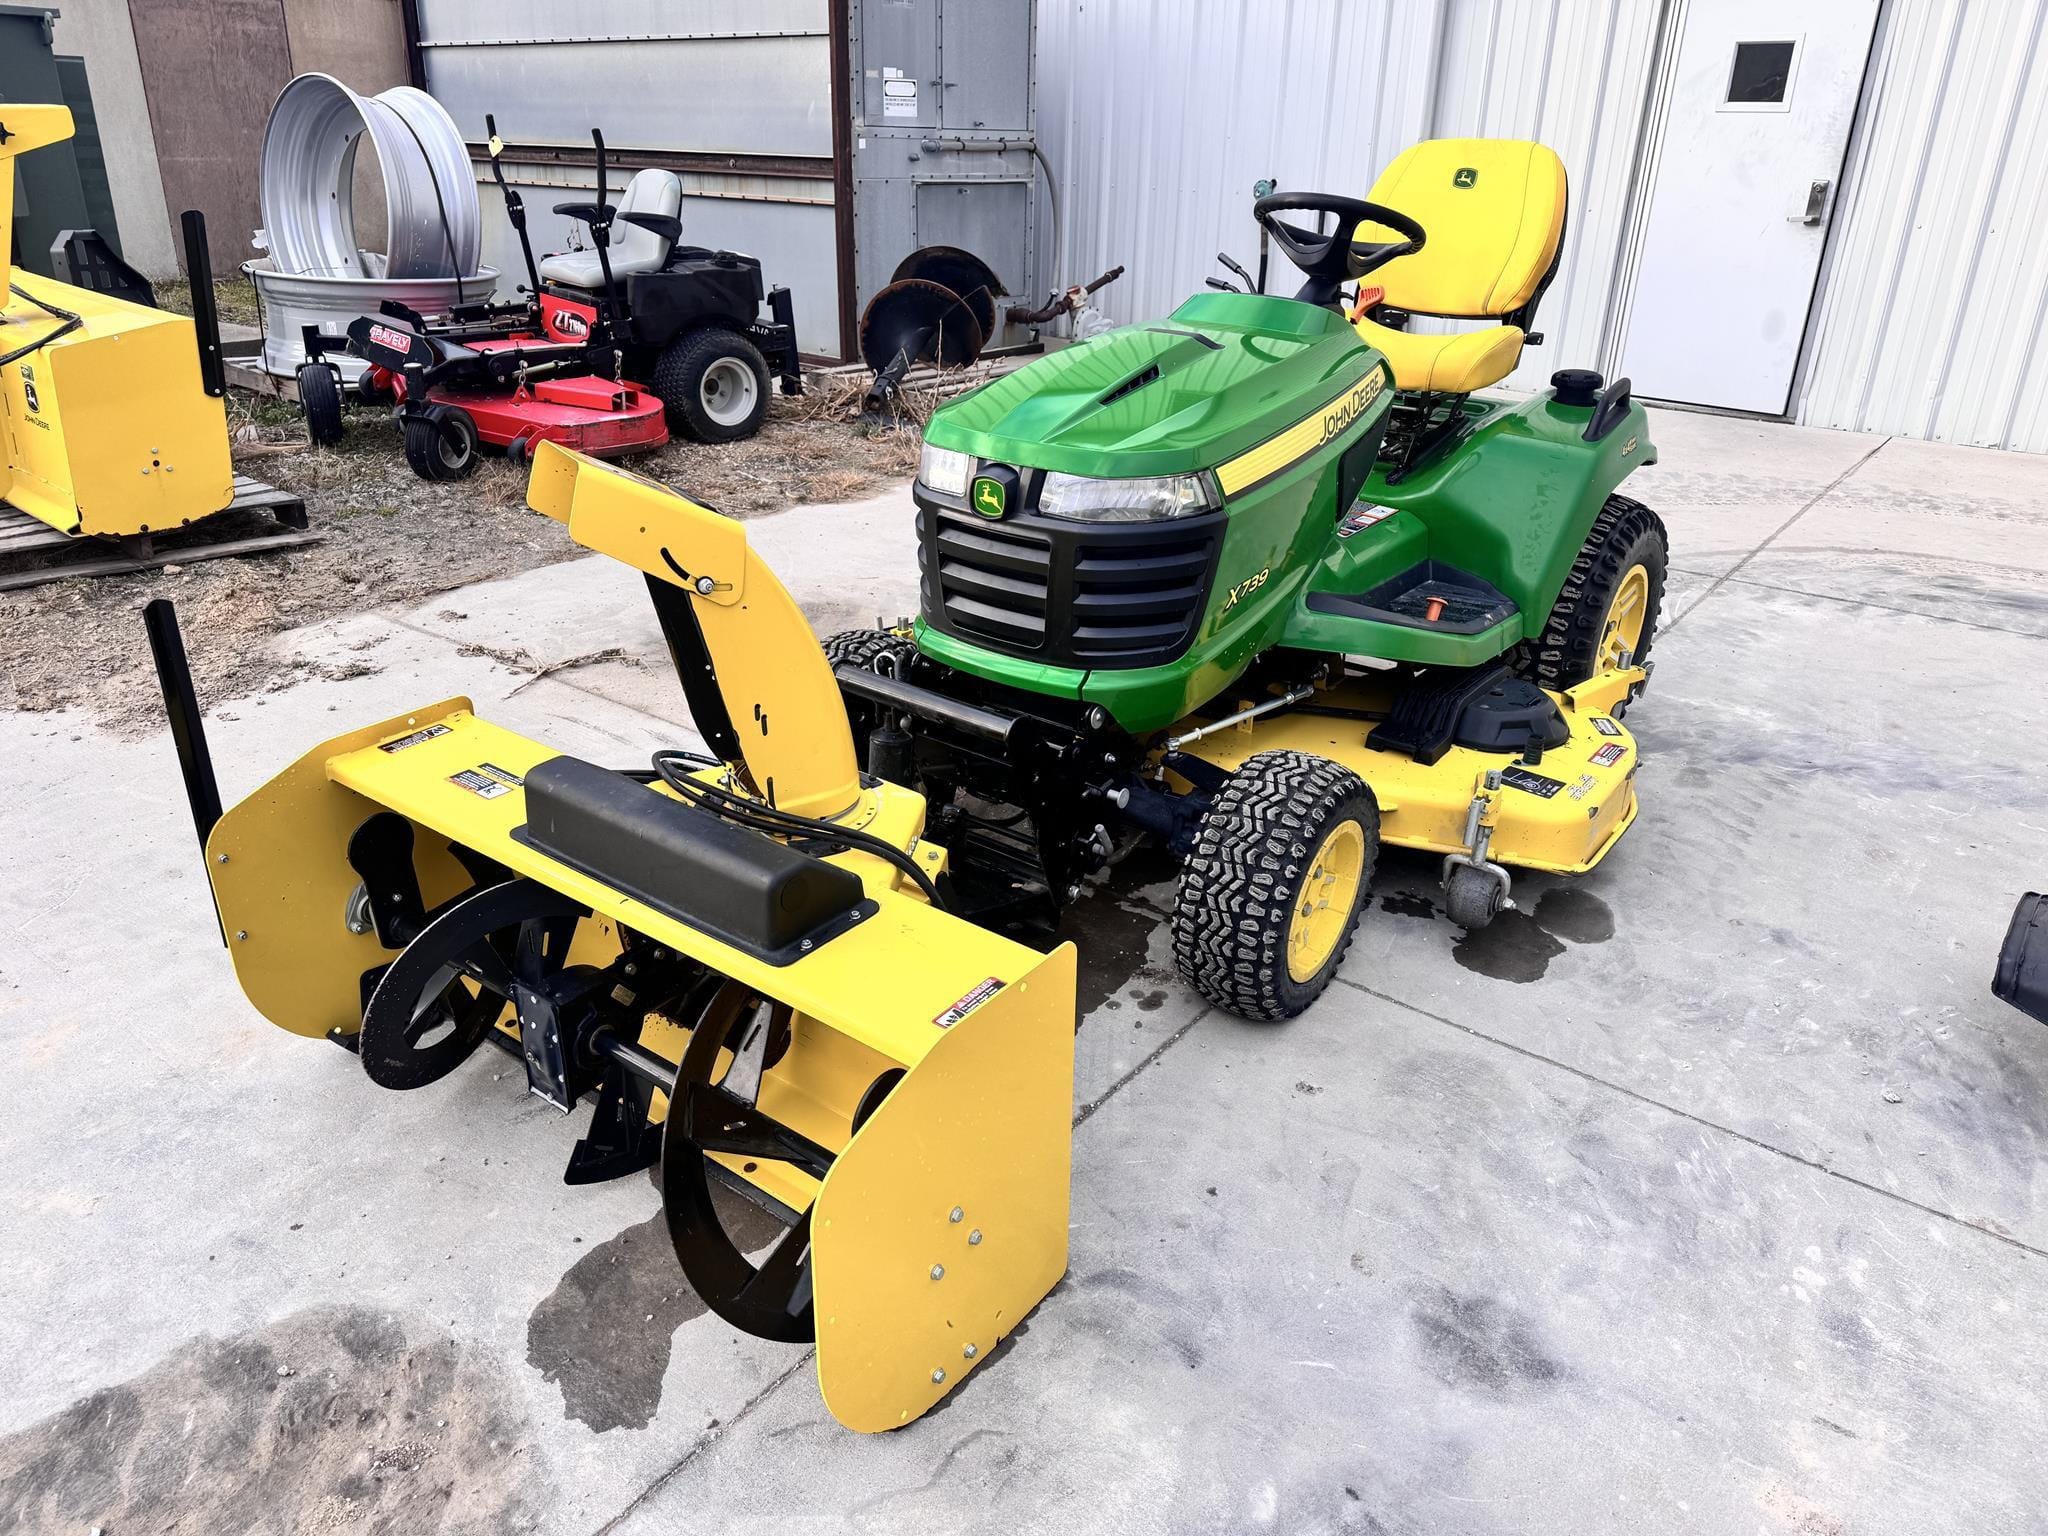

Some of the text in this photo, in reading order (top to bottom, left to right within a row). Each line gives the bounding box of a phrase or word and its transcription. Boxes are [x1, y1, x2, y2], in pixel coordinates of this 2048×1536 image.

[555, 310, 571, 331] ZT
[1319, 373, 1380, 443] JOHN DEERE
[1225, 568, 1269, 610] X739
